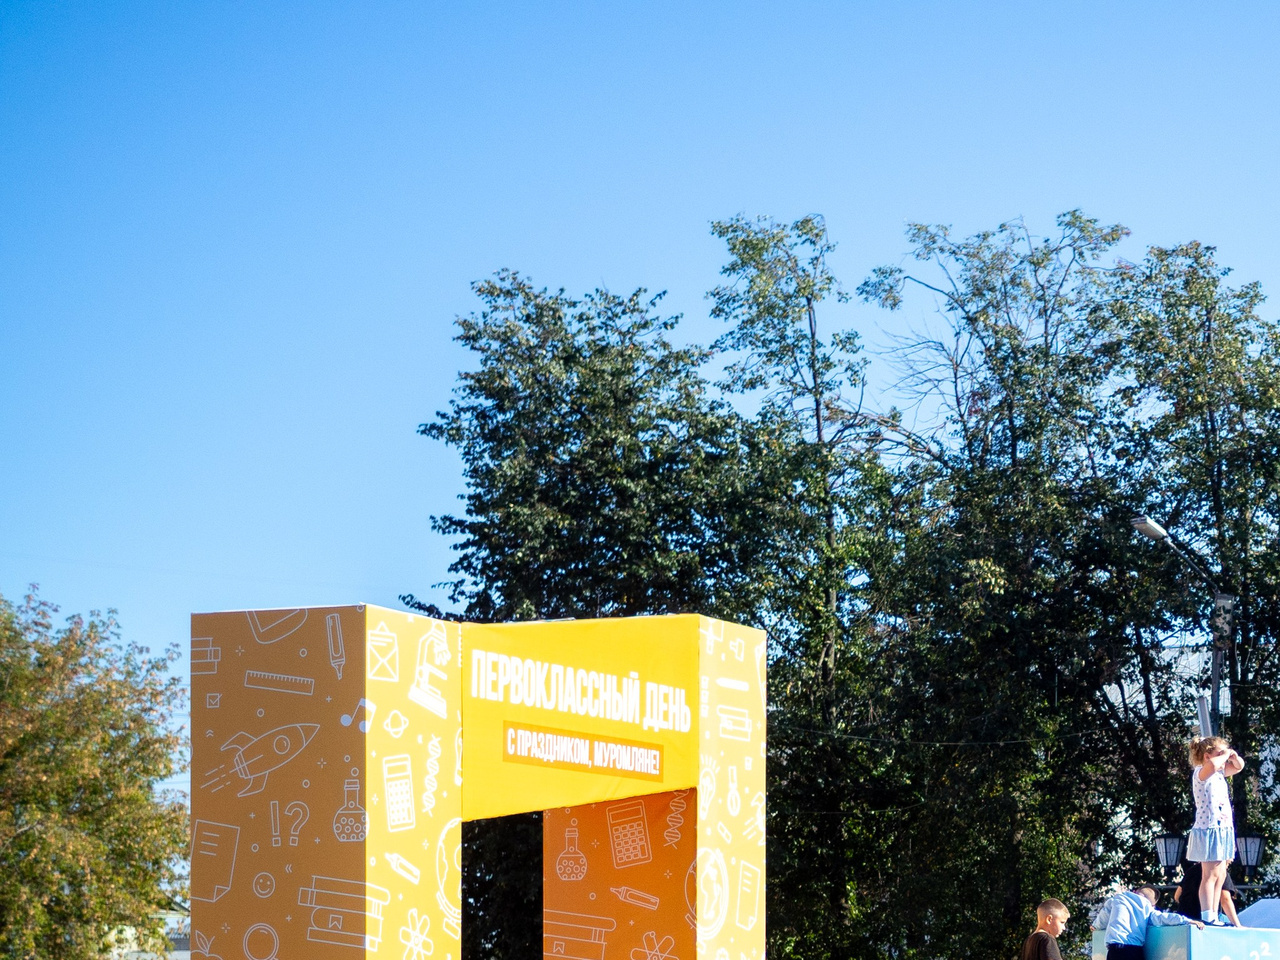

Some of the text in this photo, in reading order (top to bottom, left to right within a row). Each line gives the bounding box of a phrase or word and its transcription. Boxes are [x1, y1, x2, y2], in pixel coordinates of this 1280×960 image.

[471, 649, 691, 733] ПЕРВОКЛАССНЫЙ ДЕНЬ
[507, 728, 660, 775] С ПРАЗДНИКОМ, МУРОМЛЯНЕ!
